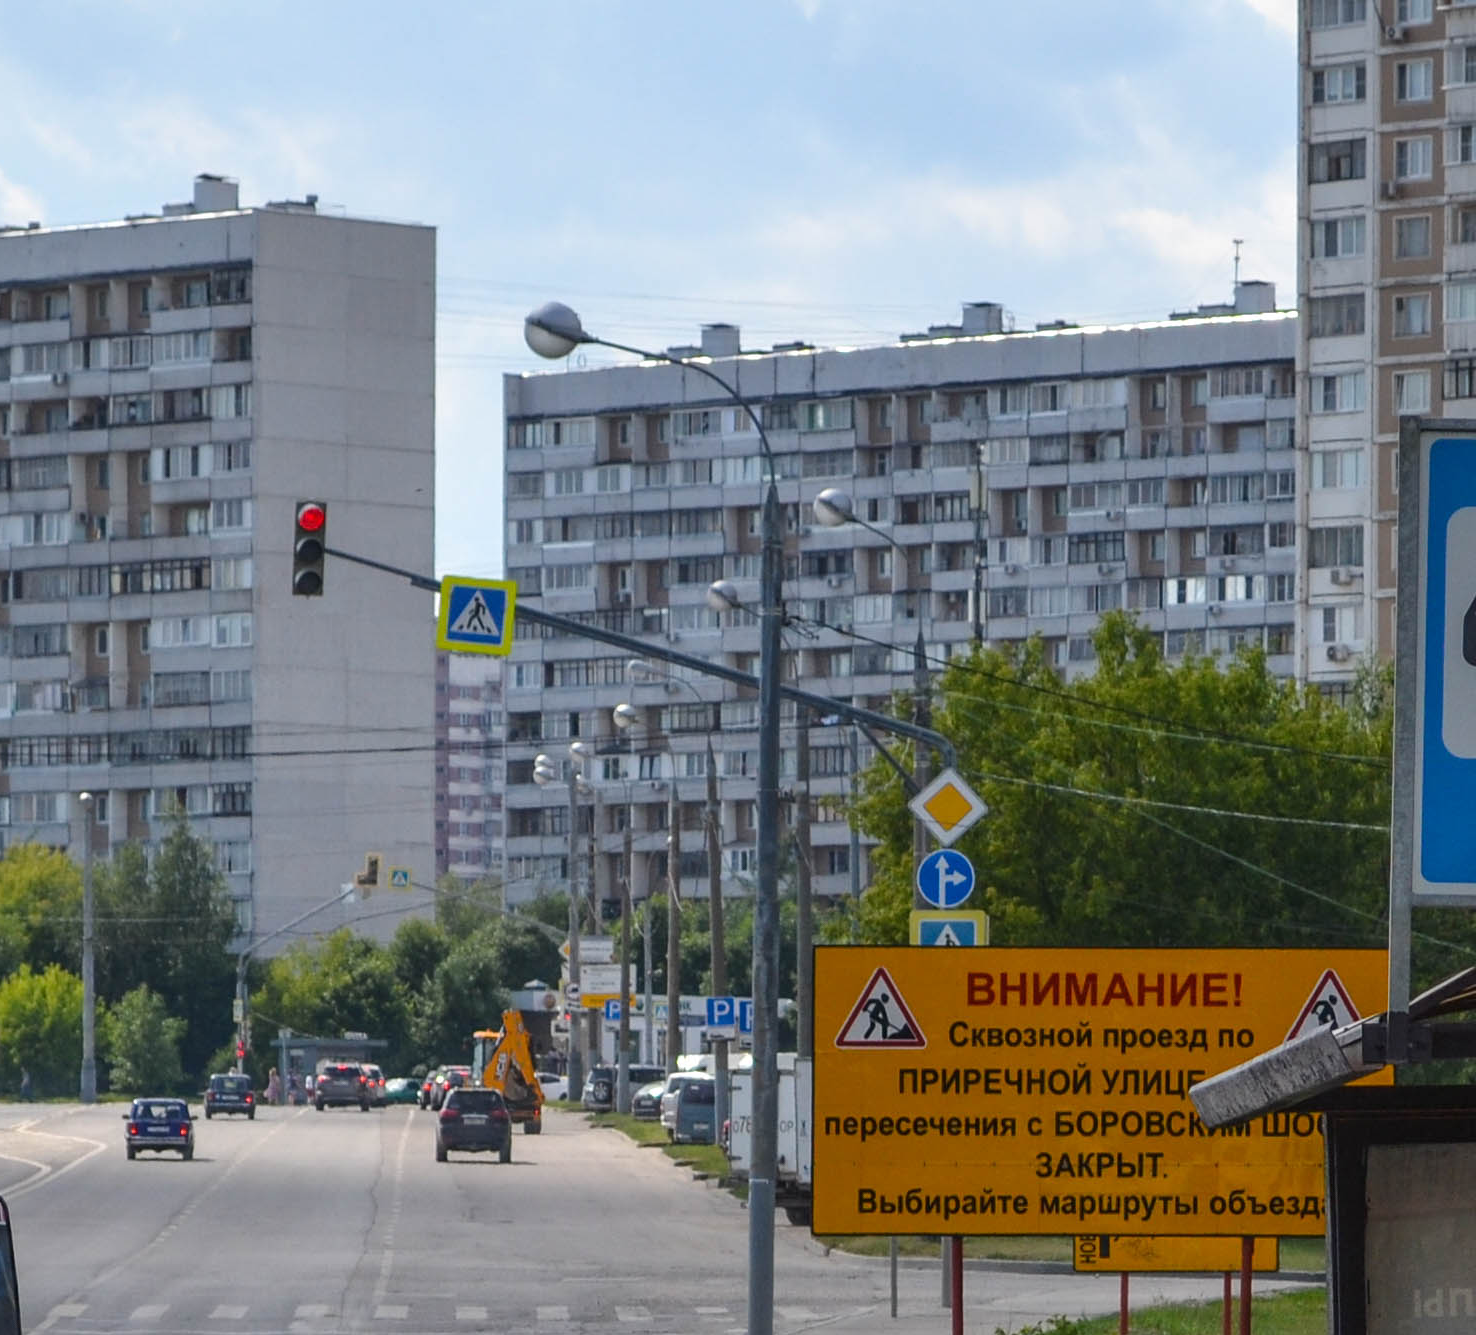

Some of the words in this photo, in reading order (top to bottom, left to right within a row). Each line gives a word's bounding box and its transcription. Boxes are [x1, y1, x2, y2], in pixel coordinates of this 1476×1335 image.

[967, 972, 1242, 1007] ВНИМАНИЕ!
[949, 1021, 1092, 1048] Сквозной
[1103, 1028, 1208, 1053] проезд
[1218, 1029, 1254, 1048] по
[898, 1063, 1092, 1095] ПРИРЕЧНОЙ
[825, 1117, 1017, 1142] пересечения
[1028, 1117, 1043, 1136] с
[1055, 1110, 1251, 1137] БОРОВСКМ
[1035, 1152, 1167, 1178] ЗАКРЫТ.
[858, 1188, 1029, 1221] Выбирайте
[1041, 1195, 1198, 1221] маршруты
